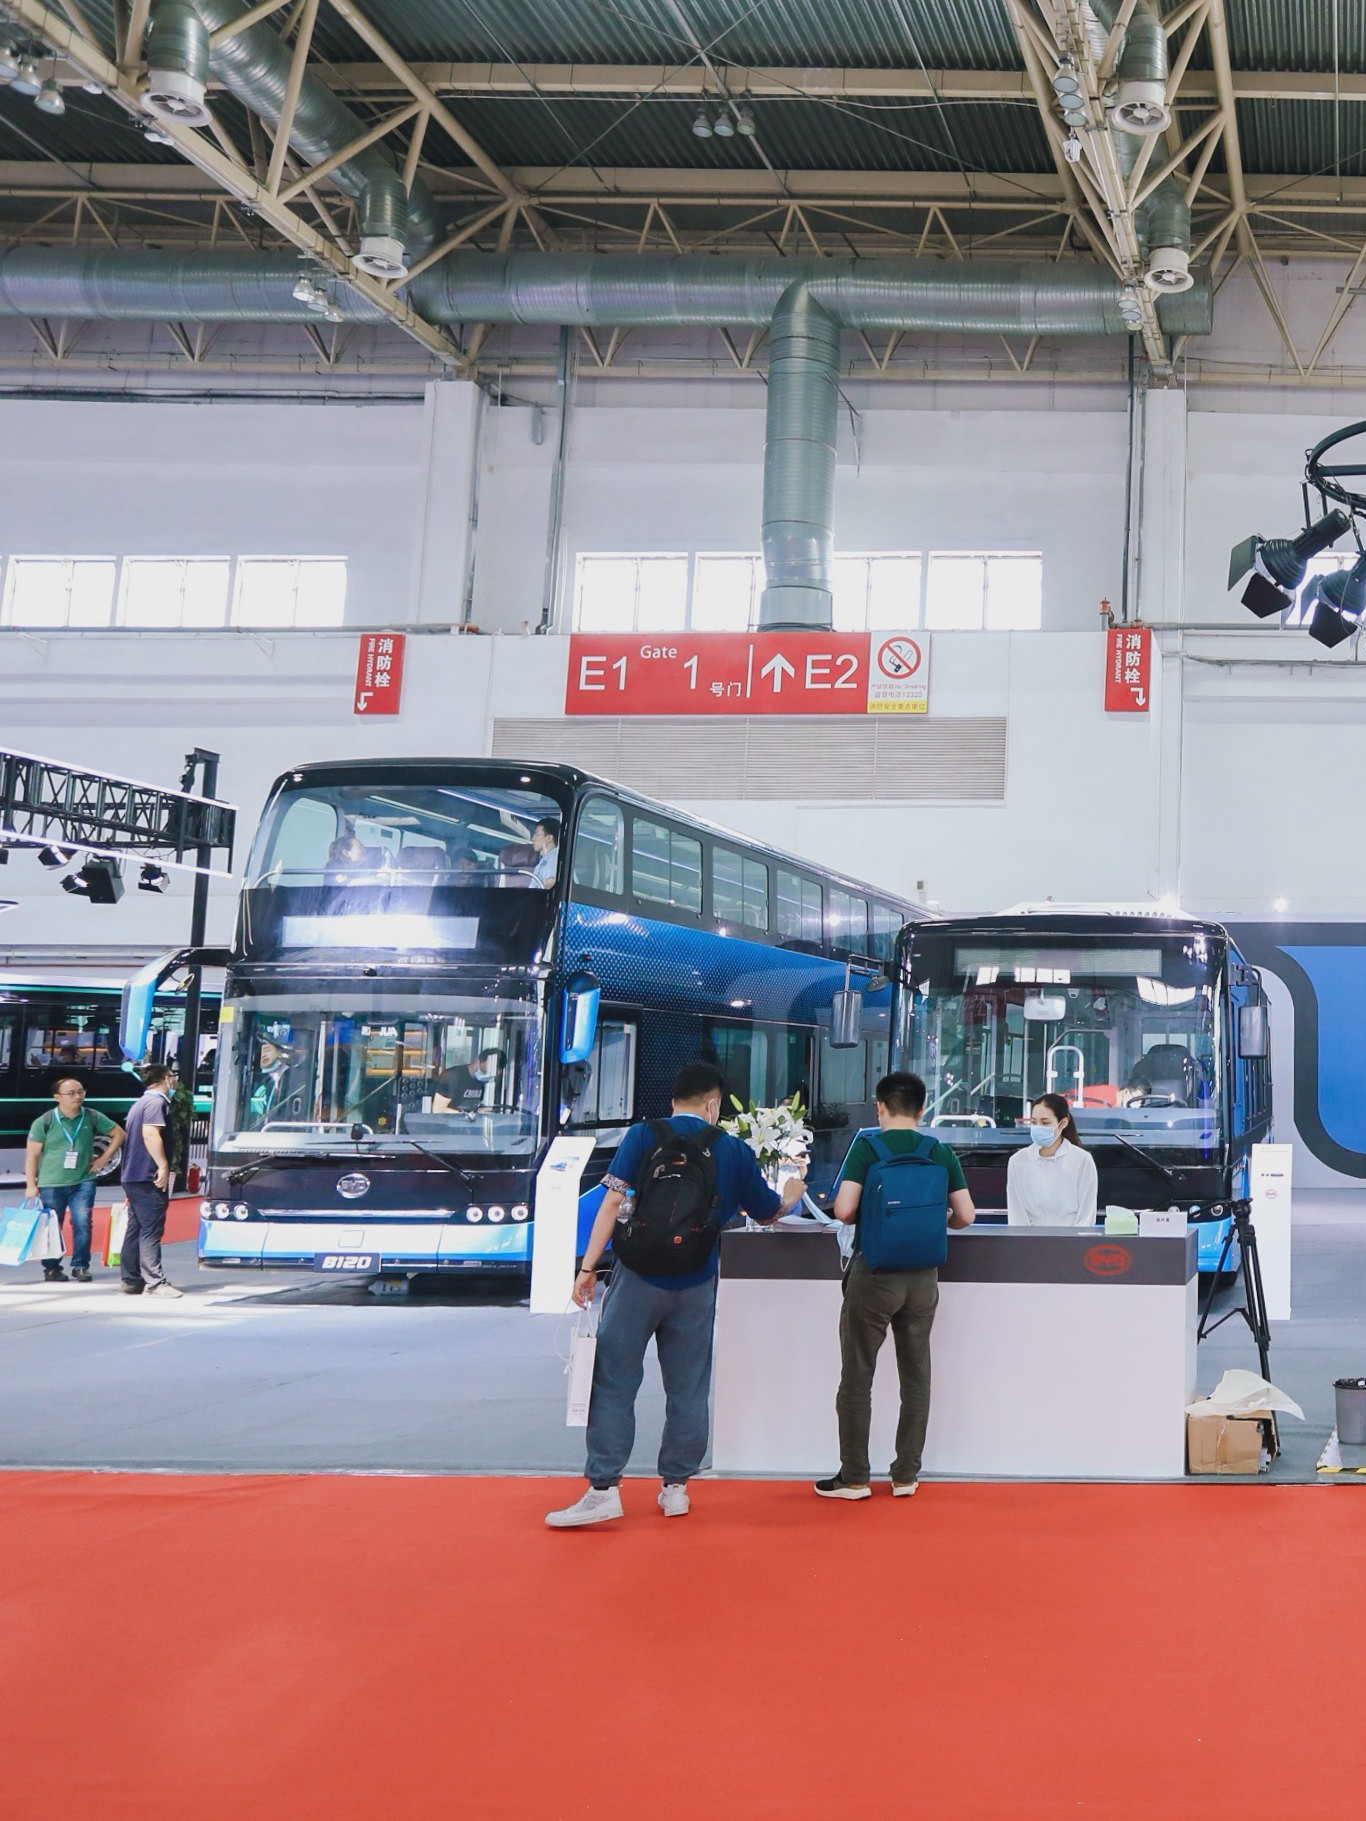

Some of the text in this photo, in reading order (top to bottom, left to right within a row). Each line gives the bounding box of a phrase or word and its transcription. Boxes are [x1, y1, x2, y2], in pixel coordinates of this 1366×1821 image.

[374, 638, 394, 687] 消防栓
[640, 645, 678, 659] Gate
[1124, 633, 1142, 684] 消防栓
[579, 655, 628, 691] E1
[805, 653, 859, 689] E2
